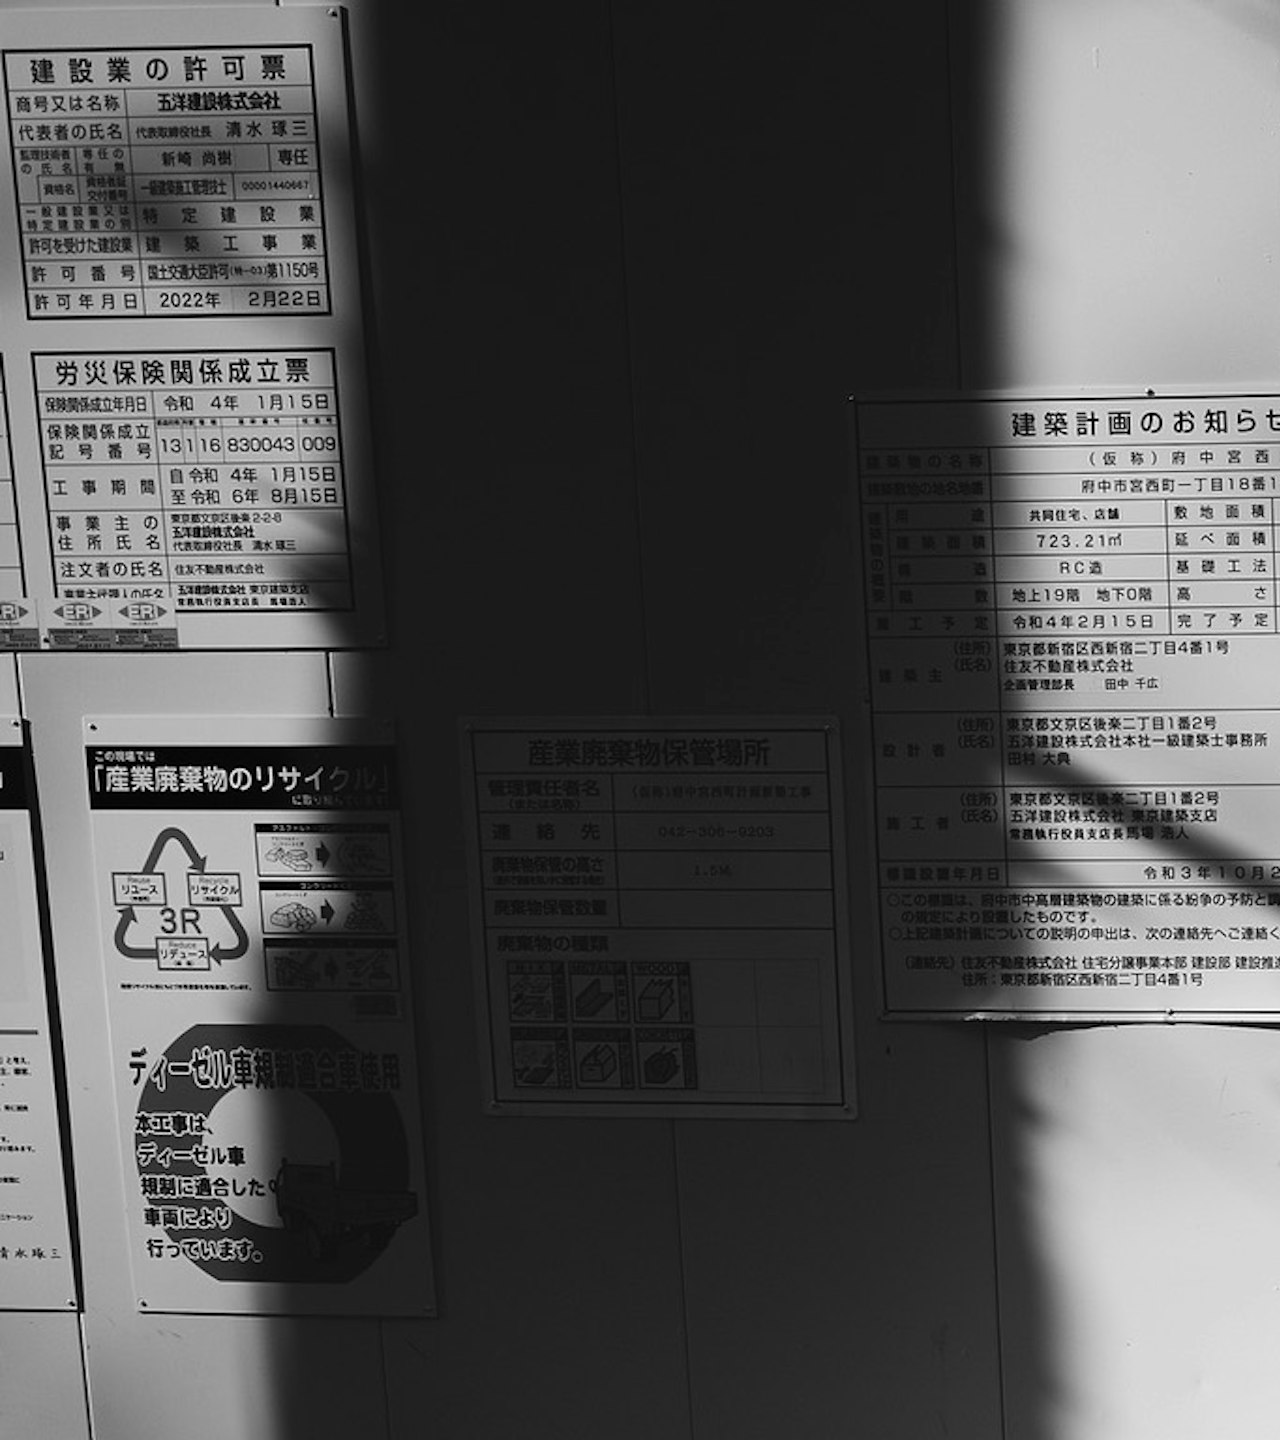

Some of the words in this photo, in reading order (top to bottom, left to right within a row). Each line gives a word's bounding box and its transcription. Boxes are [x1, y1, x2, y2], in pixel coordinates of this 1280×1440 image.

[30, 55, 286, 84] 建設業の許可票
[16, 94, 121, 113] 商号又は名称
[157, 91, 282, 112] 五洋建設株式会社
[18, 123, 123, 141] 代表者の氏名
[136, 126, 212, 139] 代表取締役社長
[278, 150, 309, 165] 専任
[142, 206, 314, 224] 特定建設業
[29, 236, 133, 255] 許可を受けた建設業
[145, 234, 317, 252] 建築工事業
[31, 265, 136, 283] 許可番号
[35, 293, 139, 310] 許可年月日
[159, 291, 221, 308] 2022年
[248, 290, 321, 307] 2月22日
[56, 358, 310, 385] 労災保険関係成立票
[45, 395, 147, 412] 保険関係成立年月日
[164, 395, 194, 411] 令和
[210, 395, 239, 410] 4年
[258, 394, 329, 409] 1月15日
[47, 423, 151, 440] 保険関係成立
[49, 443, 152, 460] 記号番号
[160, 438, 182, 453] 13
[186, 438, 194, 452] 1
[200, 437, 221, 452] 16
[228, 437, 295, 452] 830043
[302, 437, 337, 451] 009
[171, 468, 182, 484] 自
[189, 467, 218, 483] 令和
[231, 467, 258, 483] 4年
[272, 467, 336, 483] 1月15日
[53, 479, 156, 496] 工事期間
[172, 490, 186, 505] 至
[191, 489, 220, 505] 令和
[232, 489, 259, 505] 6年
[272, 488, 338, 504] 8月15日
[1029, 508, 1120, 522] 共同住宅、店舗
[1174, 503, 1265, 520] 敷地面積
[56, 515, 158, 532] 事業主の
[58, 534, 161, 551] 住所氏名
[1176, 531, 1266, 547] 延べ面積
[60, 560, 164, 578] 注文者の氏名
[174, 563, 265, 576] 住友不動産株式会社
[1059, 562, 1103, 575] RC造
[1176, 559, 1267, 574] 基礎工法
[1012, 588, 1080, 603] 地上19階
[1096, 588, 1152, 602] 地下0階
[1176, 586, 1267, 601] 高さ
[1013, 614, 1153, 630] 令和4年2月15日
[1177, 613, 1269, 628] 完了予定
[1003, 641, 1229, 657] 東京都新宿区西新宿二丁目4番1号
[1004, 658, 1134, 674] 住友不動産株式会社
[1003, 678, 1075, 692] 企画管理部長
[1105, 678, 1129, 691] 田中
[1006, 716, 1217, 732] 東京都文京区後楽二丁目1番2号
[1007, 733, 1268, 749] 五洋建設株式会社本社一級建築士事務所
[528, 738, 771, 767] 産業廃棄物保管場所
[1008, 752, 1036, 766] 田村
[95, 765, 388, 793] 「産業廃棄物のリサイクル」
[488, 779, 601, 798] 管理責任者名
[1009, 791, 1220, 807] 東京都文京区後楽二丁目1番2号
[1010, 809, 1125, 824] 五洋建設株式会社
[1131, 808, 1218, 824] 東京建築支店
[492, 823, 600, 840] 連絡先
[122, 885, 158, 894] リユース
[191, 885, 239, 894] リサイクル
[160, 907, 202, 934] 3R
[497, 935, 609, 953] 廃棄物の種類
[160, 949, 207, 959] リデュース
[962, 955, 1077, 970] 住友不動産株式会社
[1082, 955, 1187, 970] 住宅分譲事業本部
[1191, 955, 1231, 970] 建設部
[129, 1046, 400, 1090] ディーゼル車規制適合車使用
[135, 1113, 214, 1136] 本工事は、
[138, 1144, 245, 1165] ディーゼル車
[140, 1176, 265, 1197] 規制に適合した
[144, 1207, 231, 1229] 車両により
[147, 1237, 265, 1264] 行っています。
